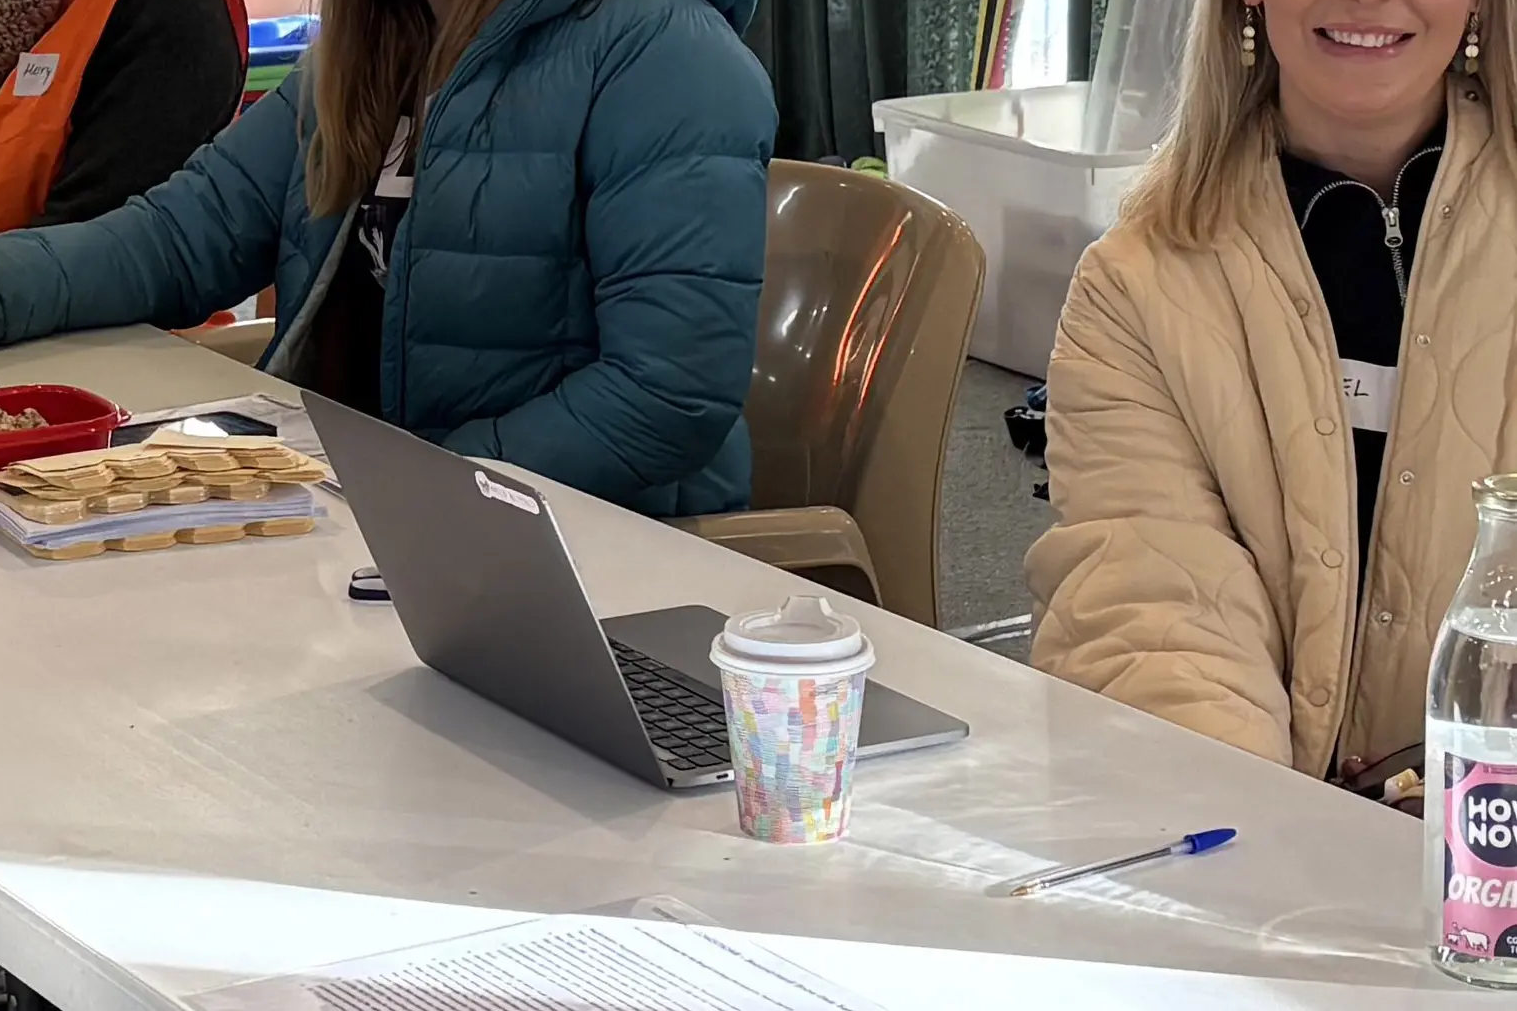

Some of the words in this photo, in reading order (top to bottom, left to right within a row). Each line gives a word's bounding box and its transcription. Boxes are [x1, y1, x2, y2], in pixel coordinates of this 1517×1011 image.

[1343, 378, 1369, 397] EL
[1468, 795, 1517, 823] HO
[1468, 820, 1517, 848] NO
